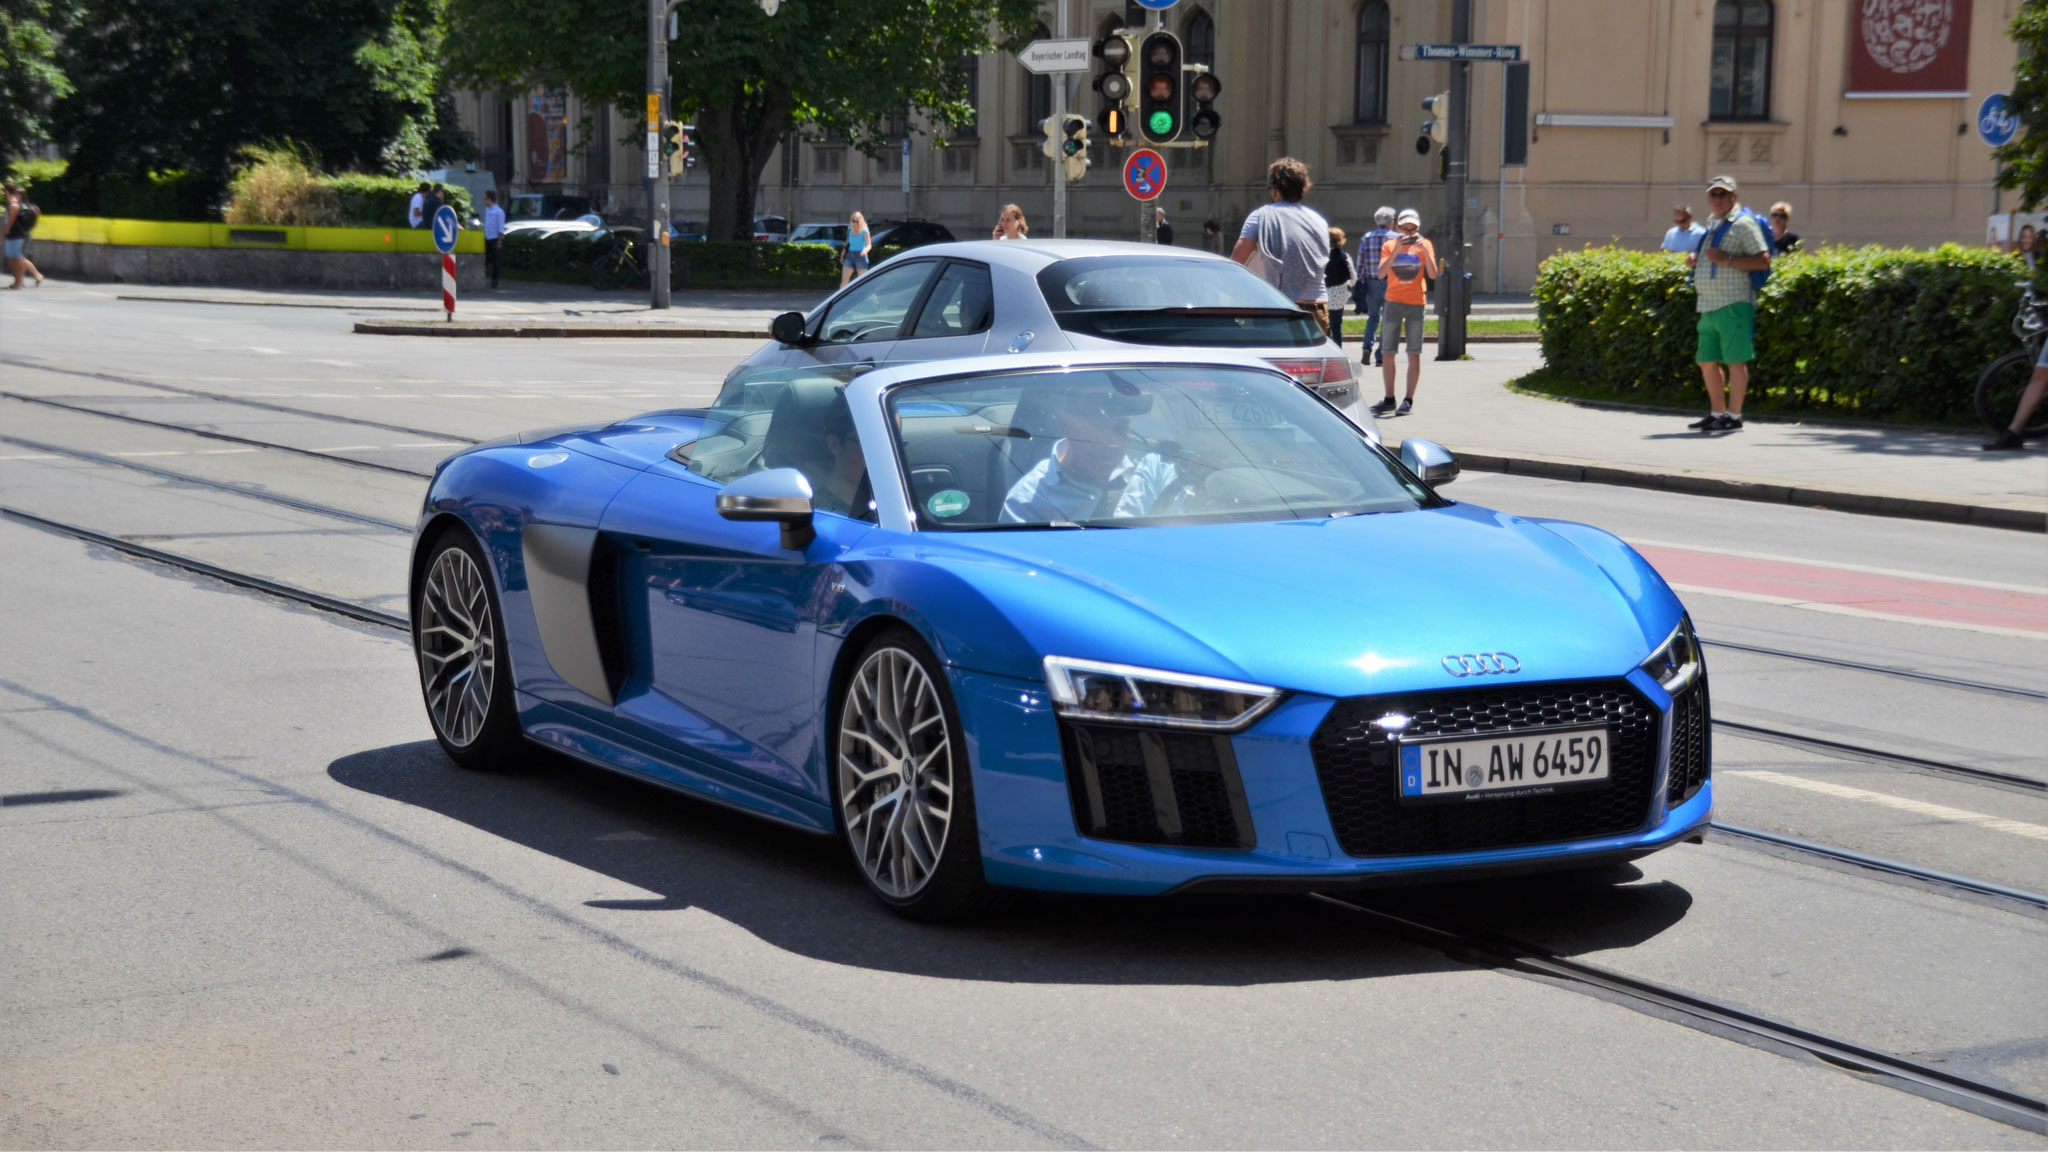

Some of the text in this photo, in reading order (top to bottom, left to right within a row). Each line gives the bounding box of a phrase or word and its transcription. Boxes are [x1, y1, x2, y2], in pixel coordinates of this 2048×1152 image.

[1031, 48, 1086, 62] Bayerischer Landtag
[1421, 45, 1516, 60] Thomas-Wimmer-Ring
[1426, 736, 1602, 788] IN AW 6459
[1407, 775, 1416, 787] D
[1484, 790, 1515, 799] Vorsprung
[1515, 788, 1532, 796] durch
[1533, 786, 1554, 794] Technik
